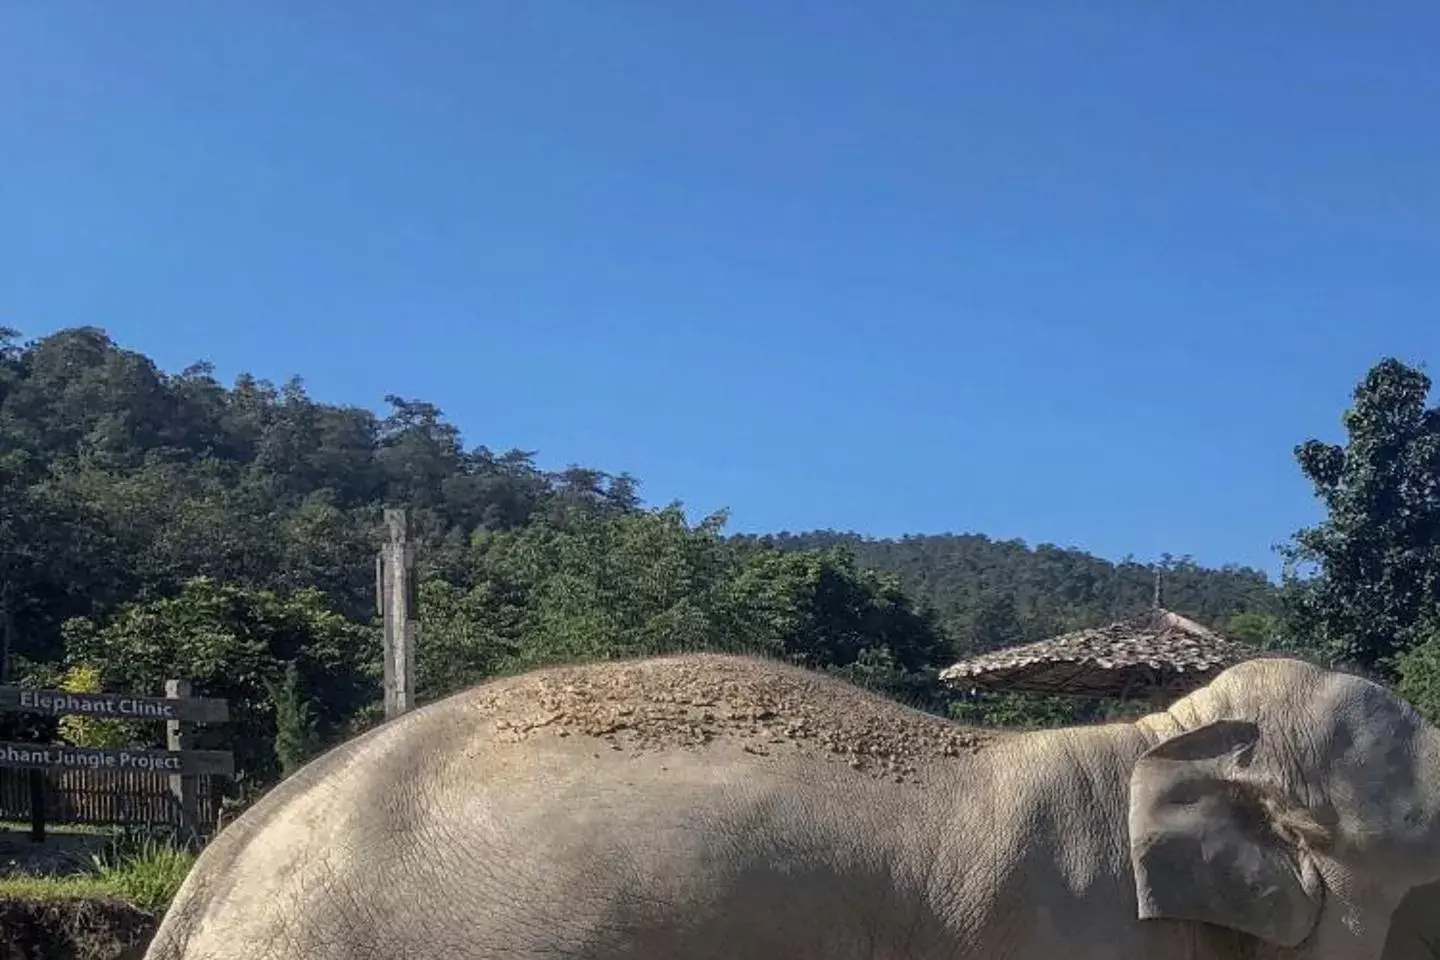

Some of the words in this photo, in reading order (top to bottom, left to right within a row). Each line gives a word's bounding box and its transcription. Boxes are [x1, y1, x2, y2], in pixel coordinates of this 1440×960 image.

[20, 692, 114, 715] Elephant
[118, 700, 173, 716] Clinic
[56, 750, 115, 769] Jungle
[120, 754, 181, 770] Project
